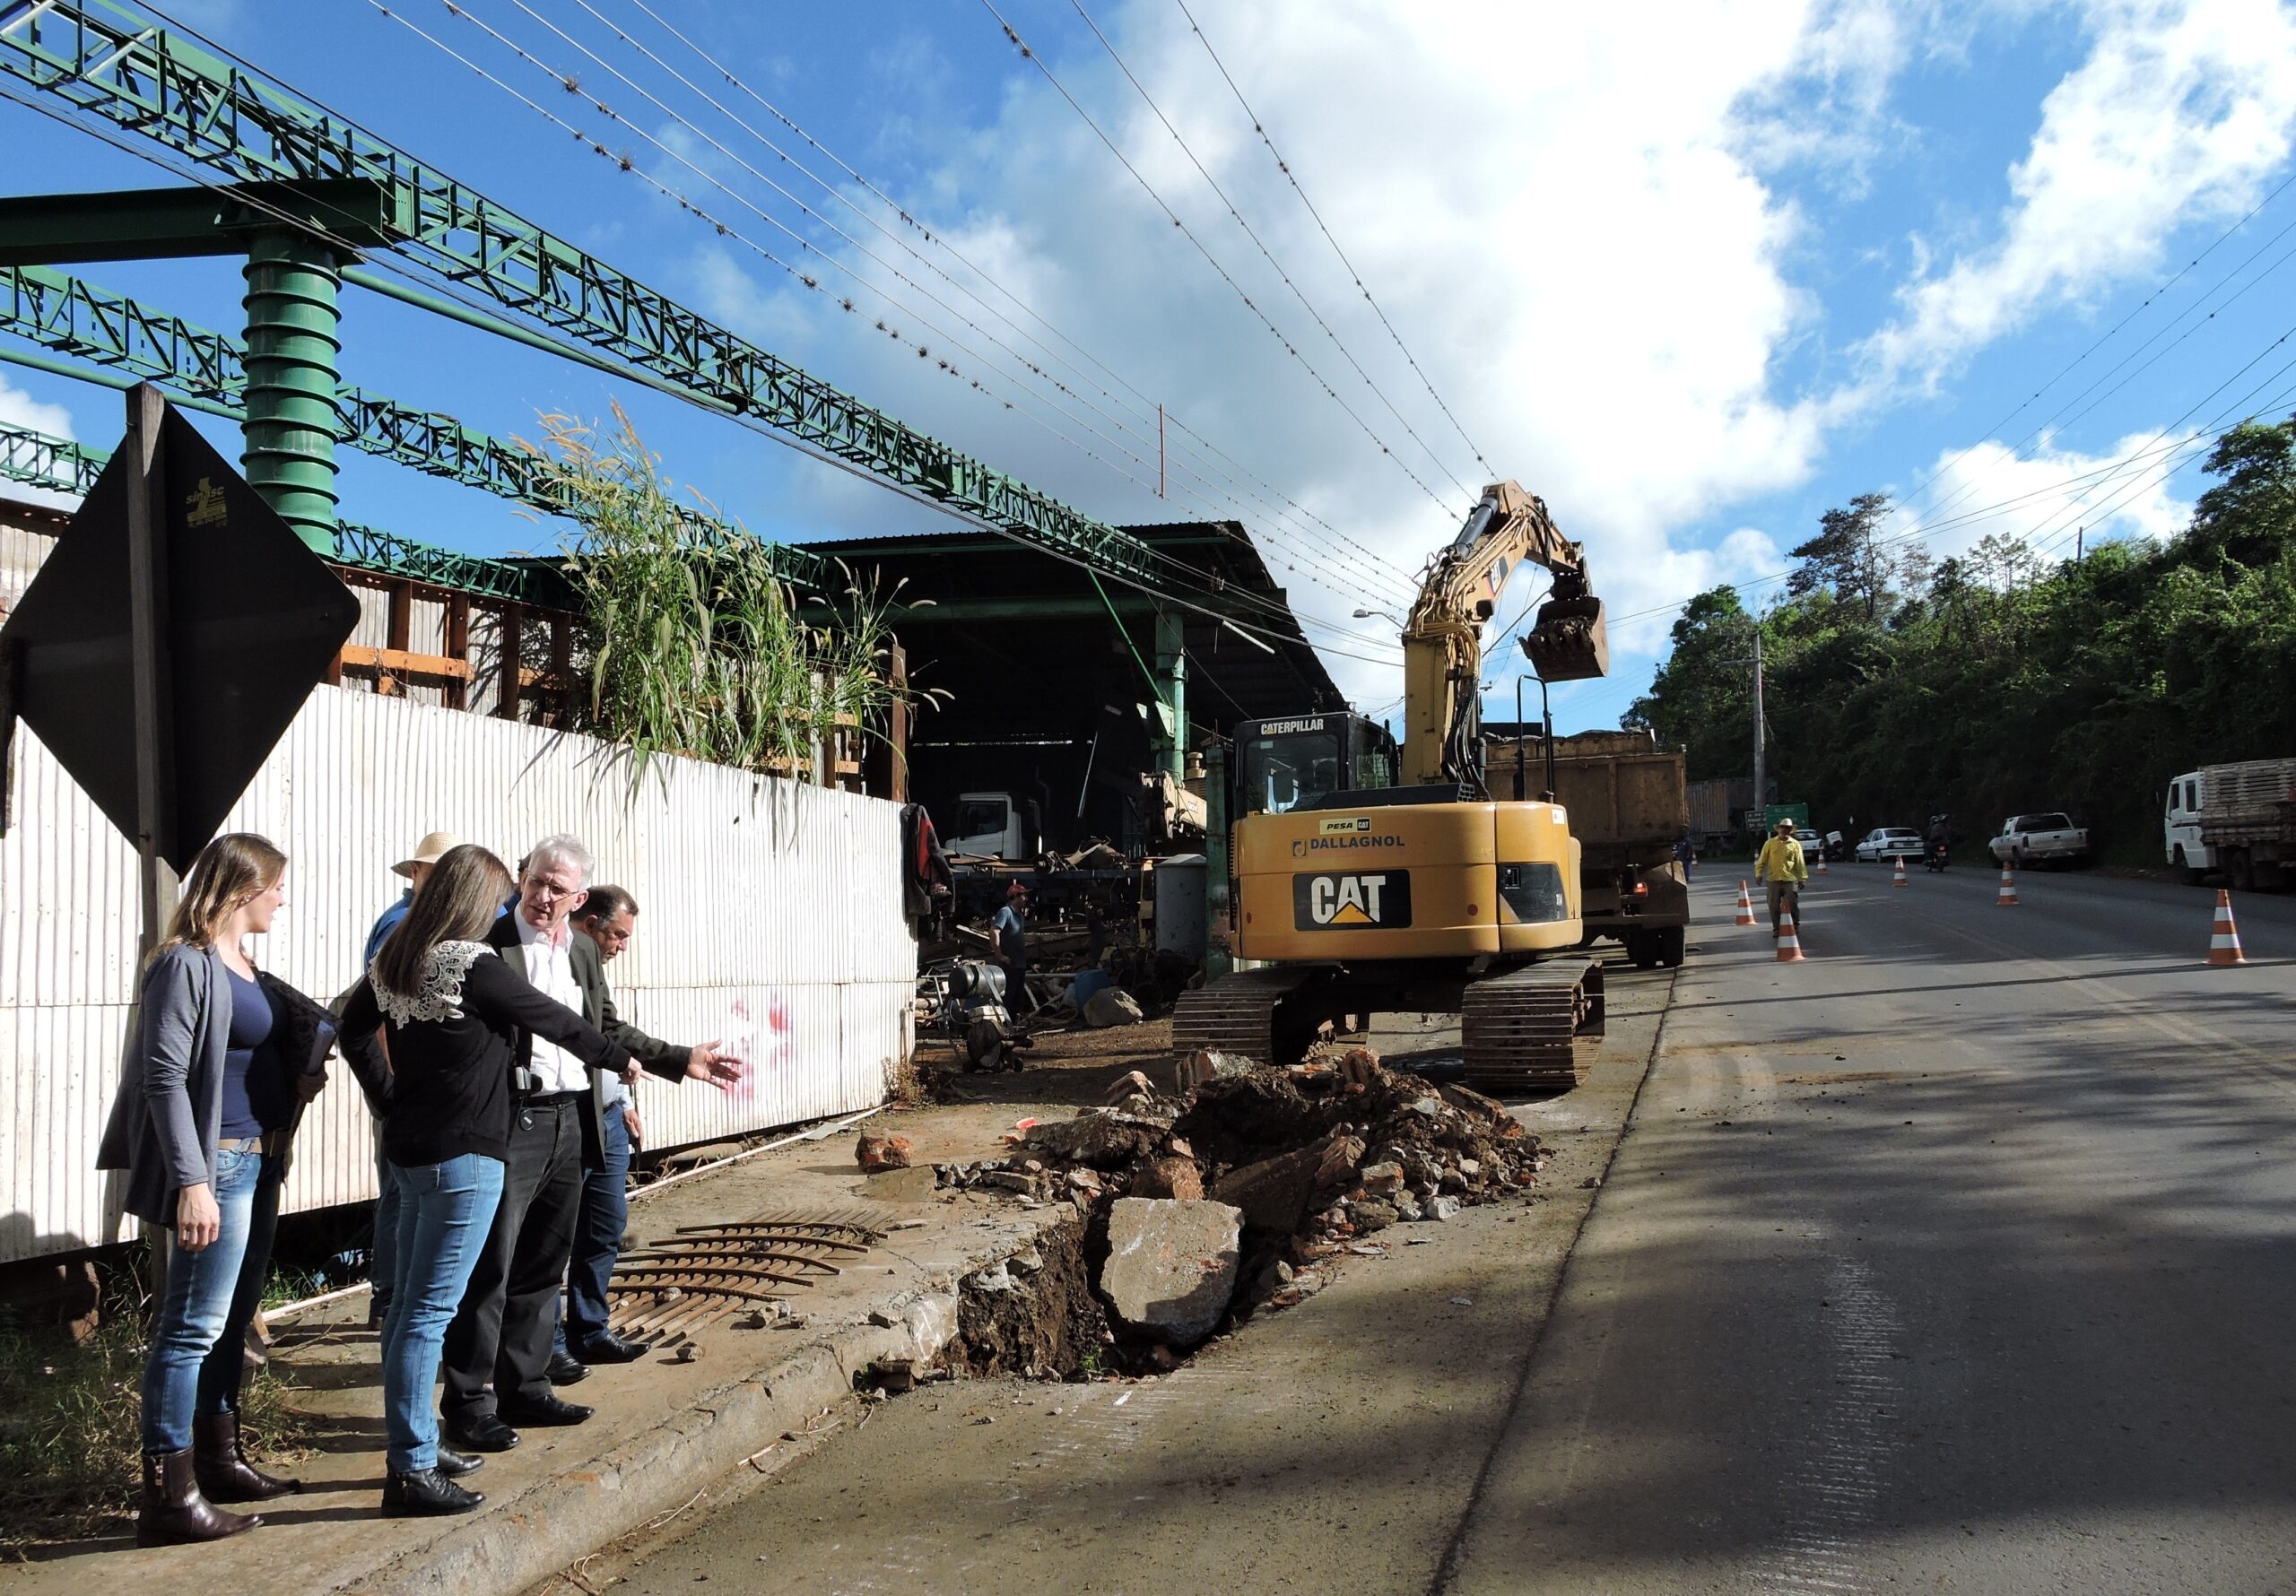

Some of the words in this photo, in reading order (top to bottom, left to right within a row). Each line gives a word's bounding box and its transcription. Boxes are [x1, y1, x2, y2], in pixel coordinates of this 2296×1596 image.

[1261, 719, 1324, 735] CATERPILLAR
[1327, 822, 1353, 830] PESA
[1358, 820, 1370, 828] CAT
[1310, 836, 1405, 849] DALLAGNOL
[1311, 875, 1386, 924] CAT
